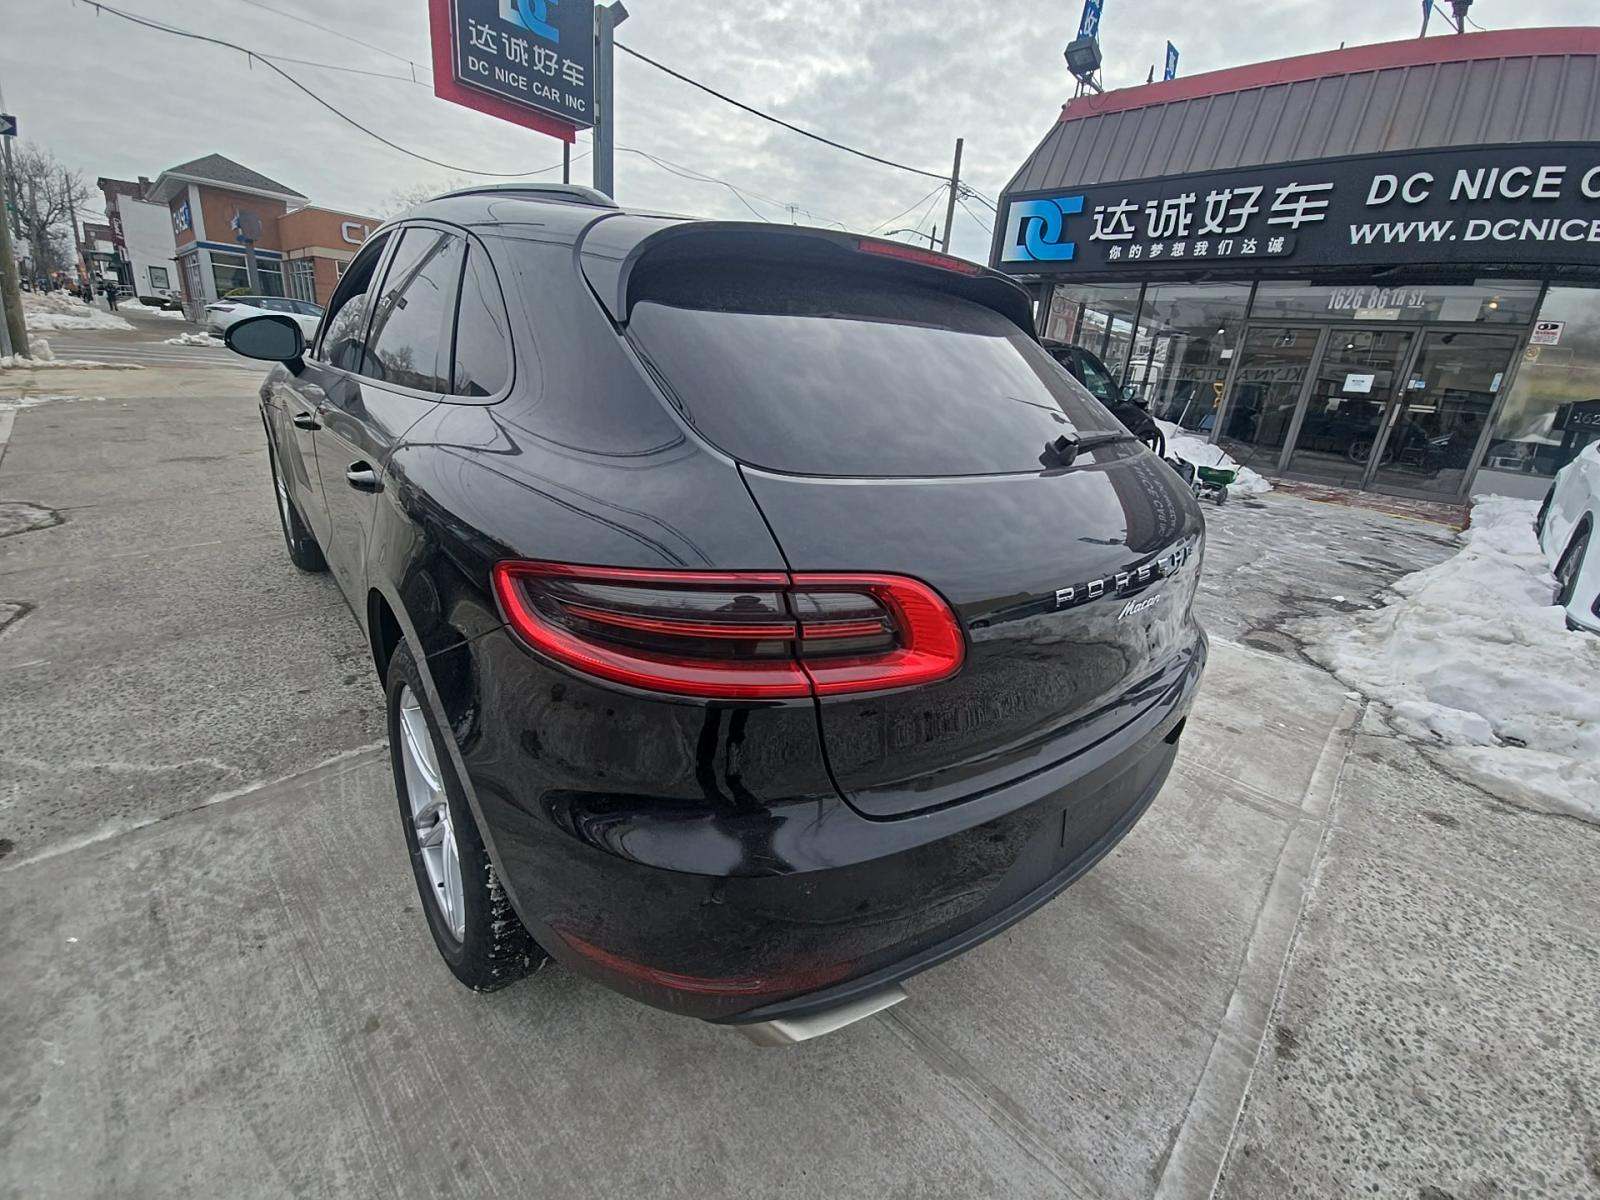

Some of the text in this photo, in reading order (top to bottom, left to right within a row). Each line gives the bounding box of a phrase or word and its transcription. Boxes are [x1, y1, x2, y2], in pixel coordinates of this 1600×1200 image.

[468, 18, 585, 87] 达诚好车
[468, 55, 586, 112] DC NICE CAR INC
[1366, 171, 1435, 206] DC
[1450, 165, 1567, 201] NICE
[1089, 181, 1335, 241] 达诚好车
[1108, 236, 1284, 260] 你的梦想我们达诚
[1327, 287, 1366, 310] 1626
[1117, 594, 1161, 621] Macan
